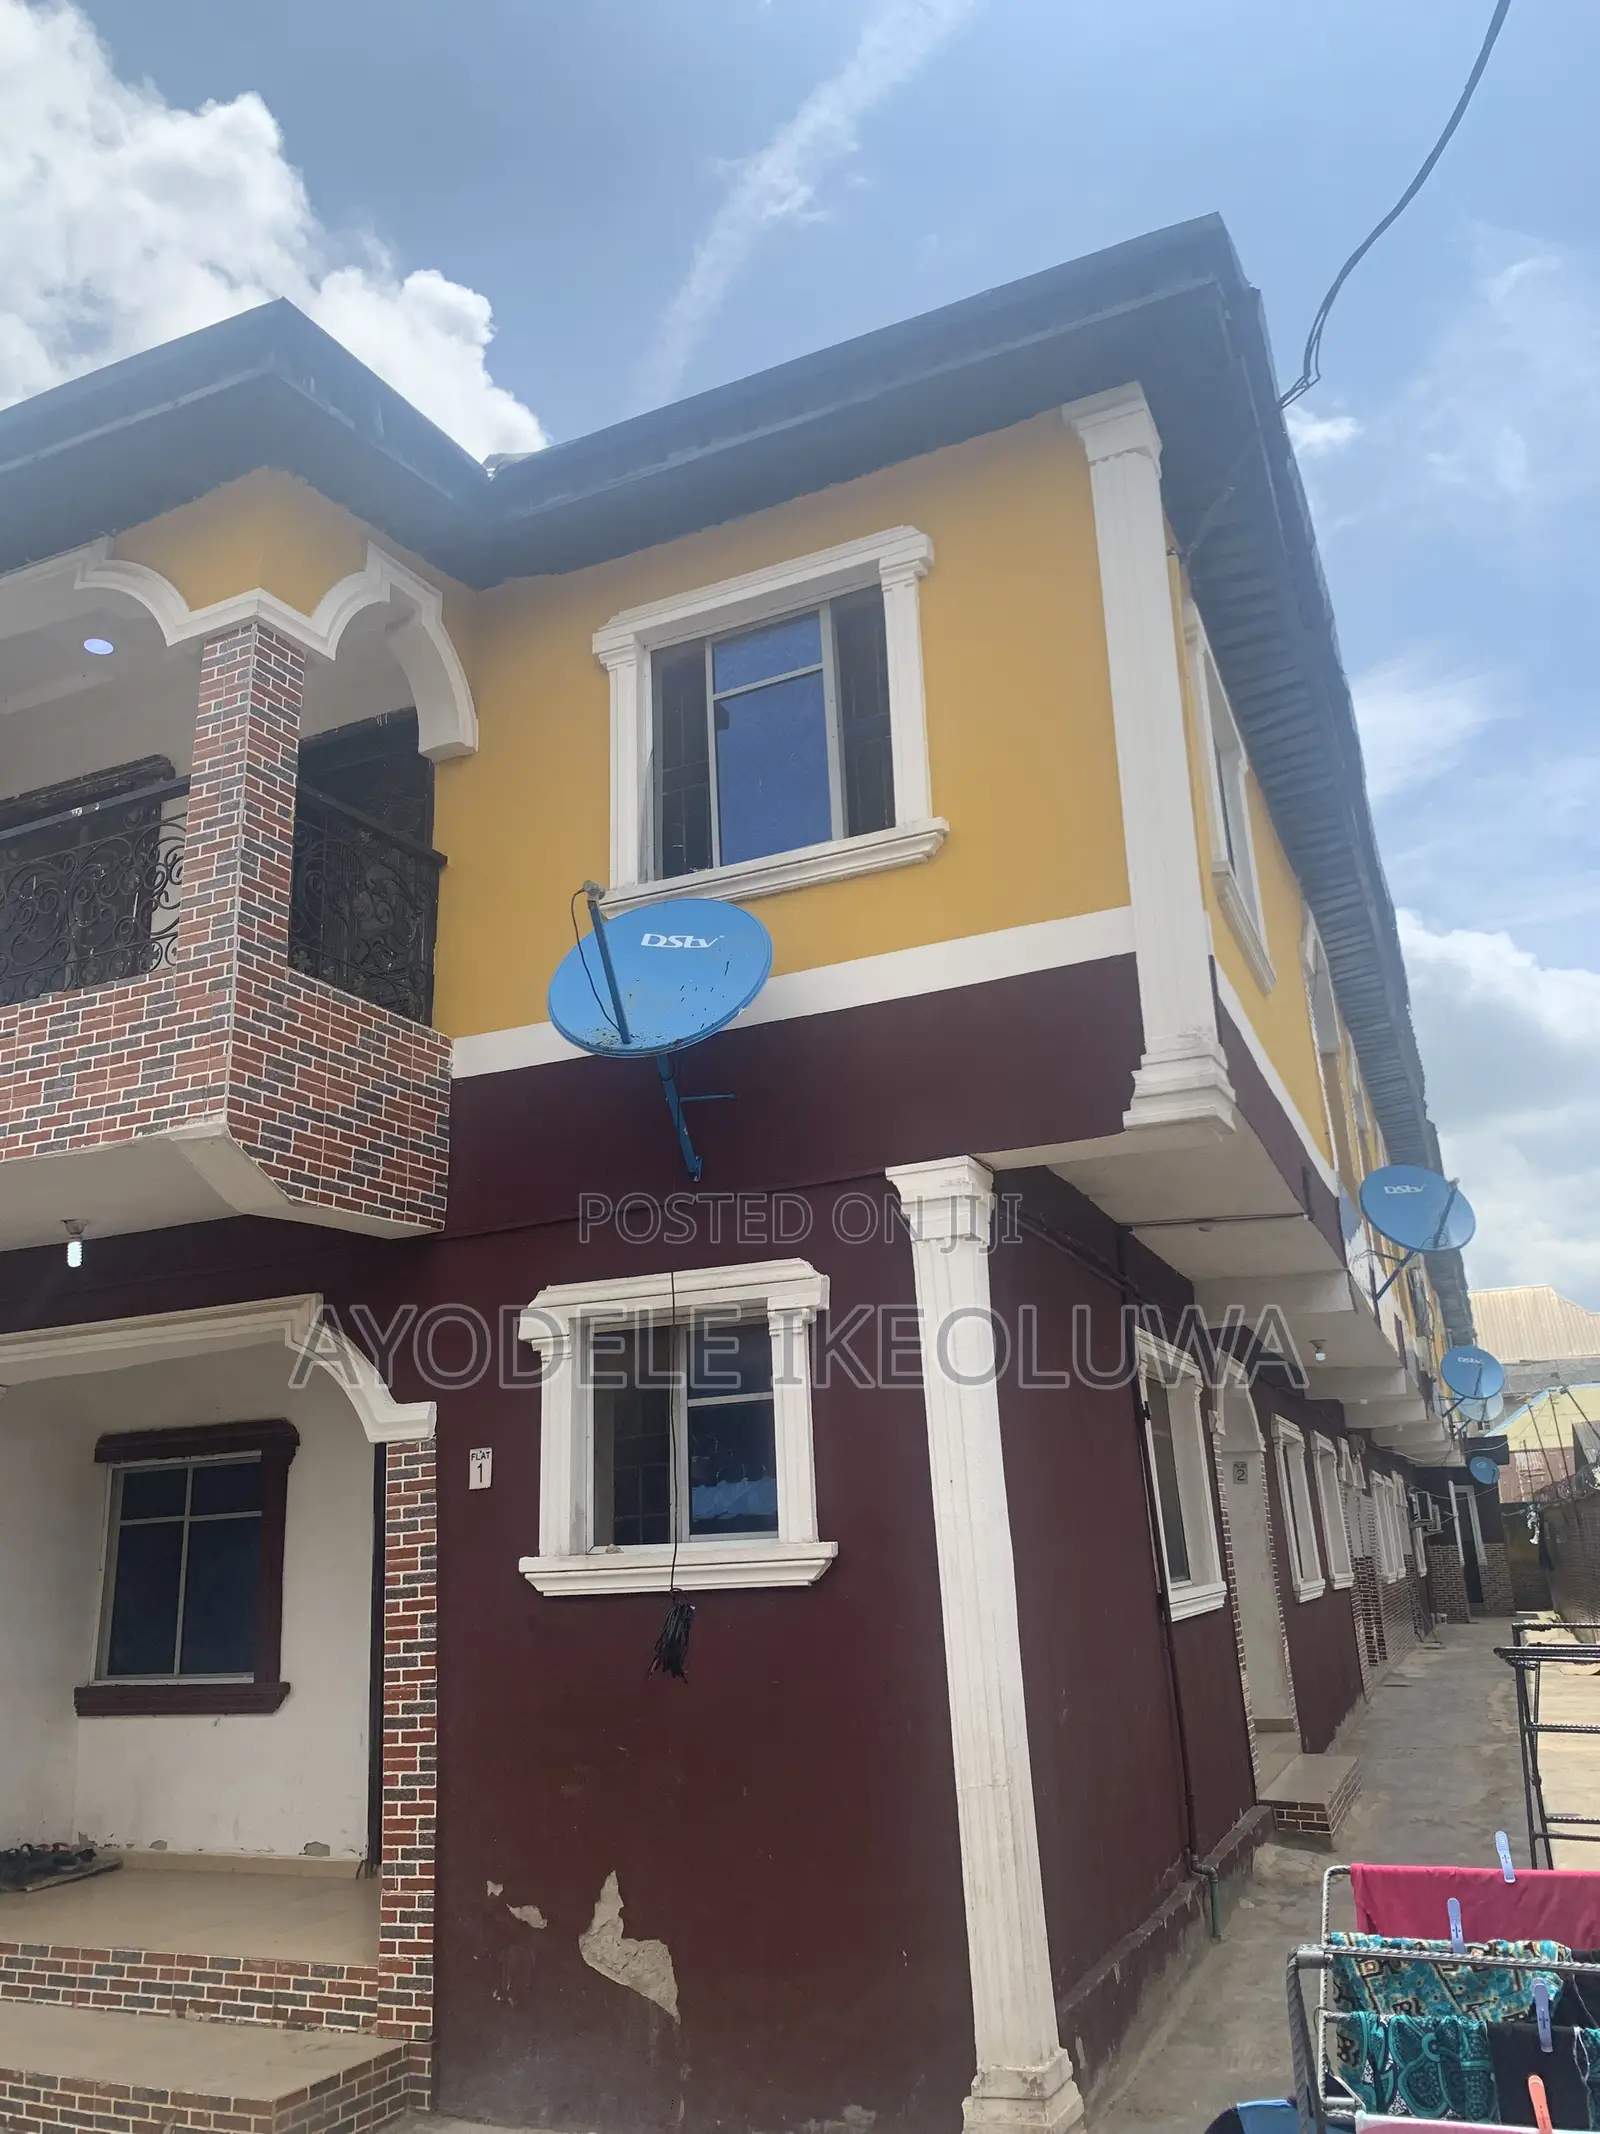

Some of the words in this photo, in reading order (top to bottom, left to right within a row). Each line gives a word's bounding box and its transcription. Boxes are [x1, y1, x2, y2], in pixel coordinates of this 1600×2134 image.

[640, 933, 719, 949] DStv
[471, 1451, 490, 1461] FLAT
[477, 1463, 483, 1483] 1
[1237, 1469, 1246, 1481] 2
